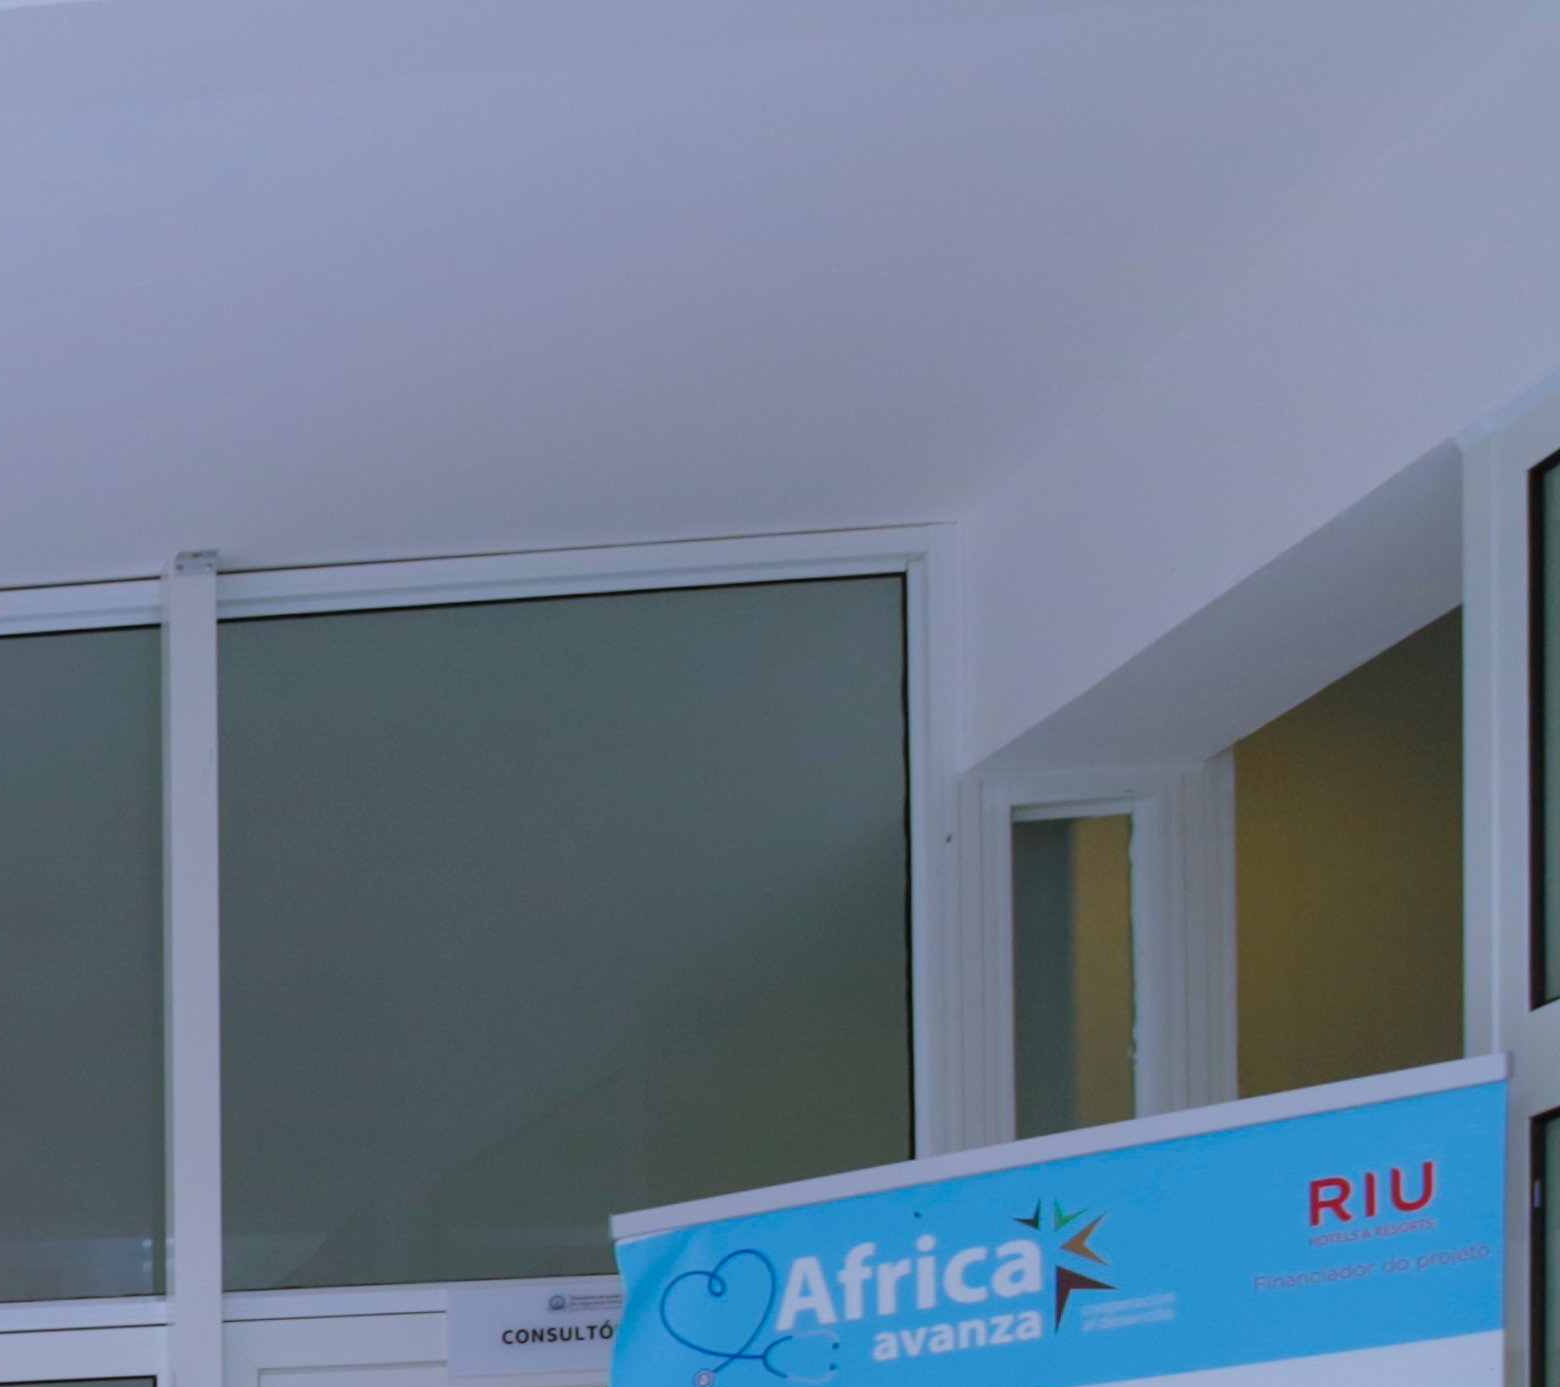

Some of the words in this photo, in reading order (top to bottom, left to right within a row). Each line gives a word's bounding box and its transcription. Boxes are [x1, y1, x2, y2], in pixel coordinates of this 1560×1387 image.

[1308, 1161, 1435, 1227] RIU
[1308, 1229, 1360, 1247] HOTELS
[1362, 1228, 1372, 1239] &
[1374, 1218, 1436, 1237] RESORTS
[776, 1233, 1043, 1331] Africa
[1253, 1260, 1376, 1291] Financiador
[1381, 1256, 1410, 1274] do
[1416, 1243, 1491, 1270] projeto
[501, 1320, 618, 1345] CONSULTÓ
[871, 1307, 1043, 1364] avanza
